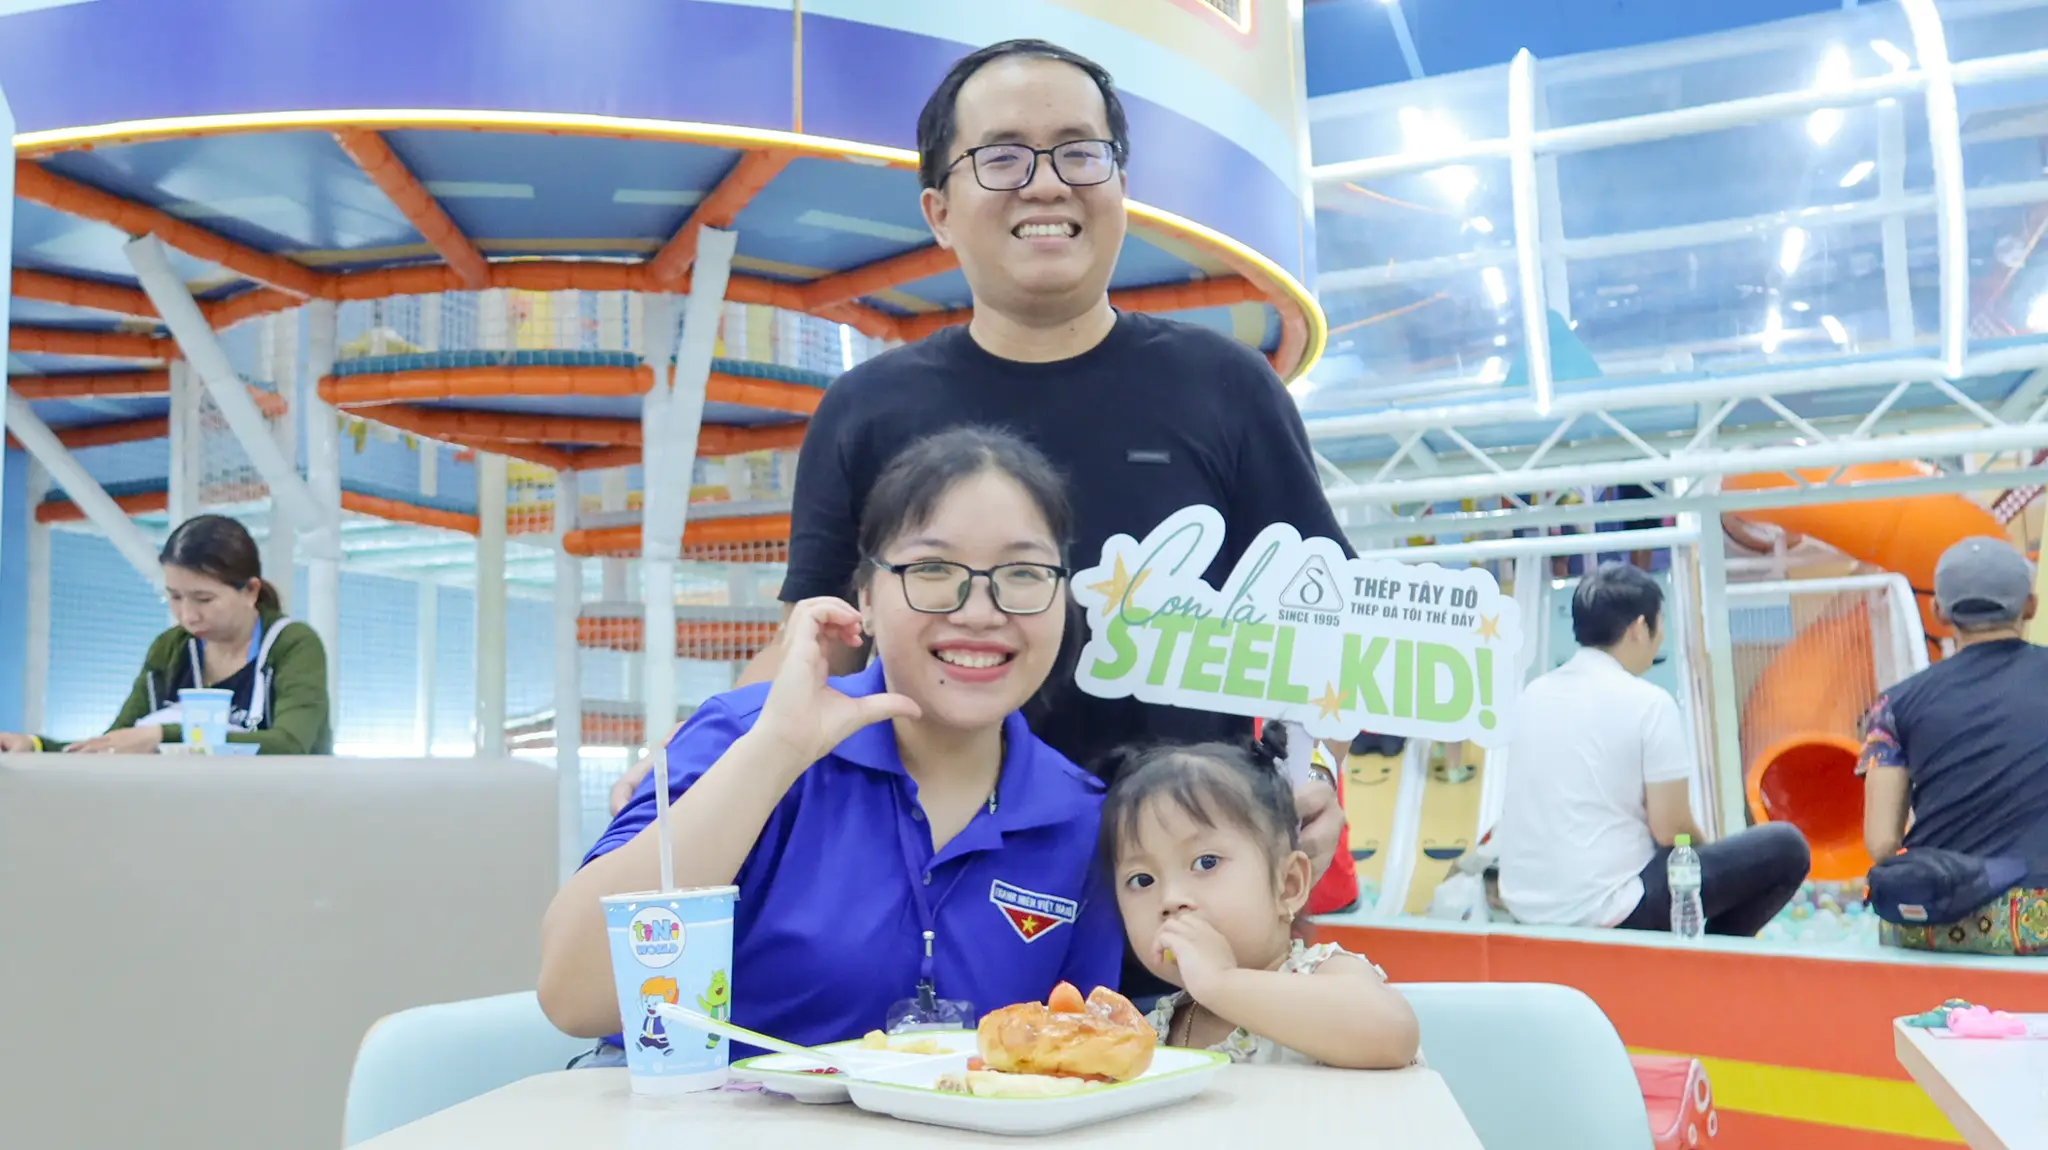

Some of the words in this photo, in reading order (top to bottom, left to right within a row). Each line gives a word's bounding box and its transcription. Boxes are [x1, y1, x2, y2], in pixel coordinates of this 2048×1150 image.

[1120, 522, 1212, 626] Con
[1221, 540, 1280, 628] là
[1353, 576, 1401, 601] THÉP
[1408, 580, 1444, 605] TÂY
[1450, 584, 1478, 609] ĐÔ
[1278, 609, 1309, 624] SINCE
[1313, 611, 1341, 627] 1995
[1090, 607, 1309, 705] STEEL
[1338, 633, 1497, 730] KID!
[636, 943, 679, 955] WORLD
